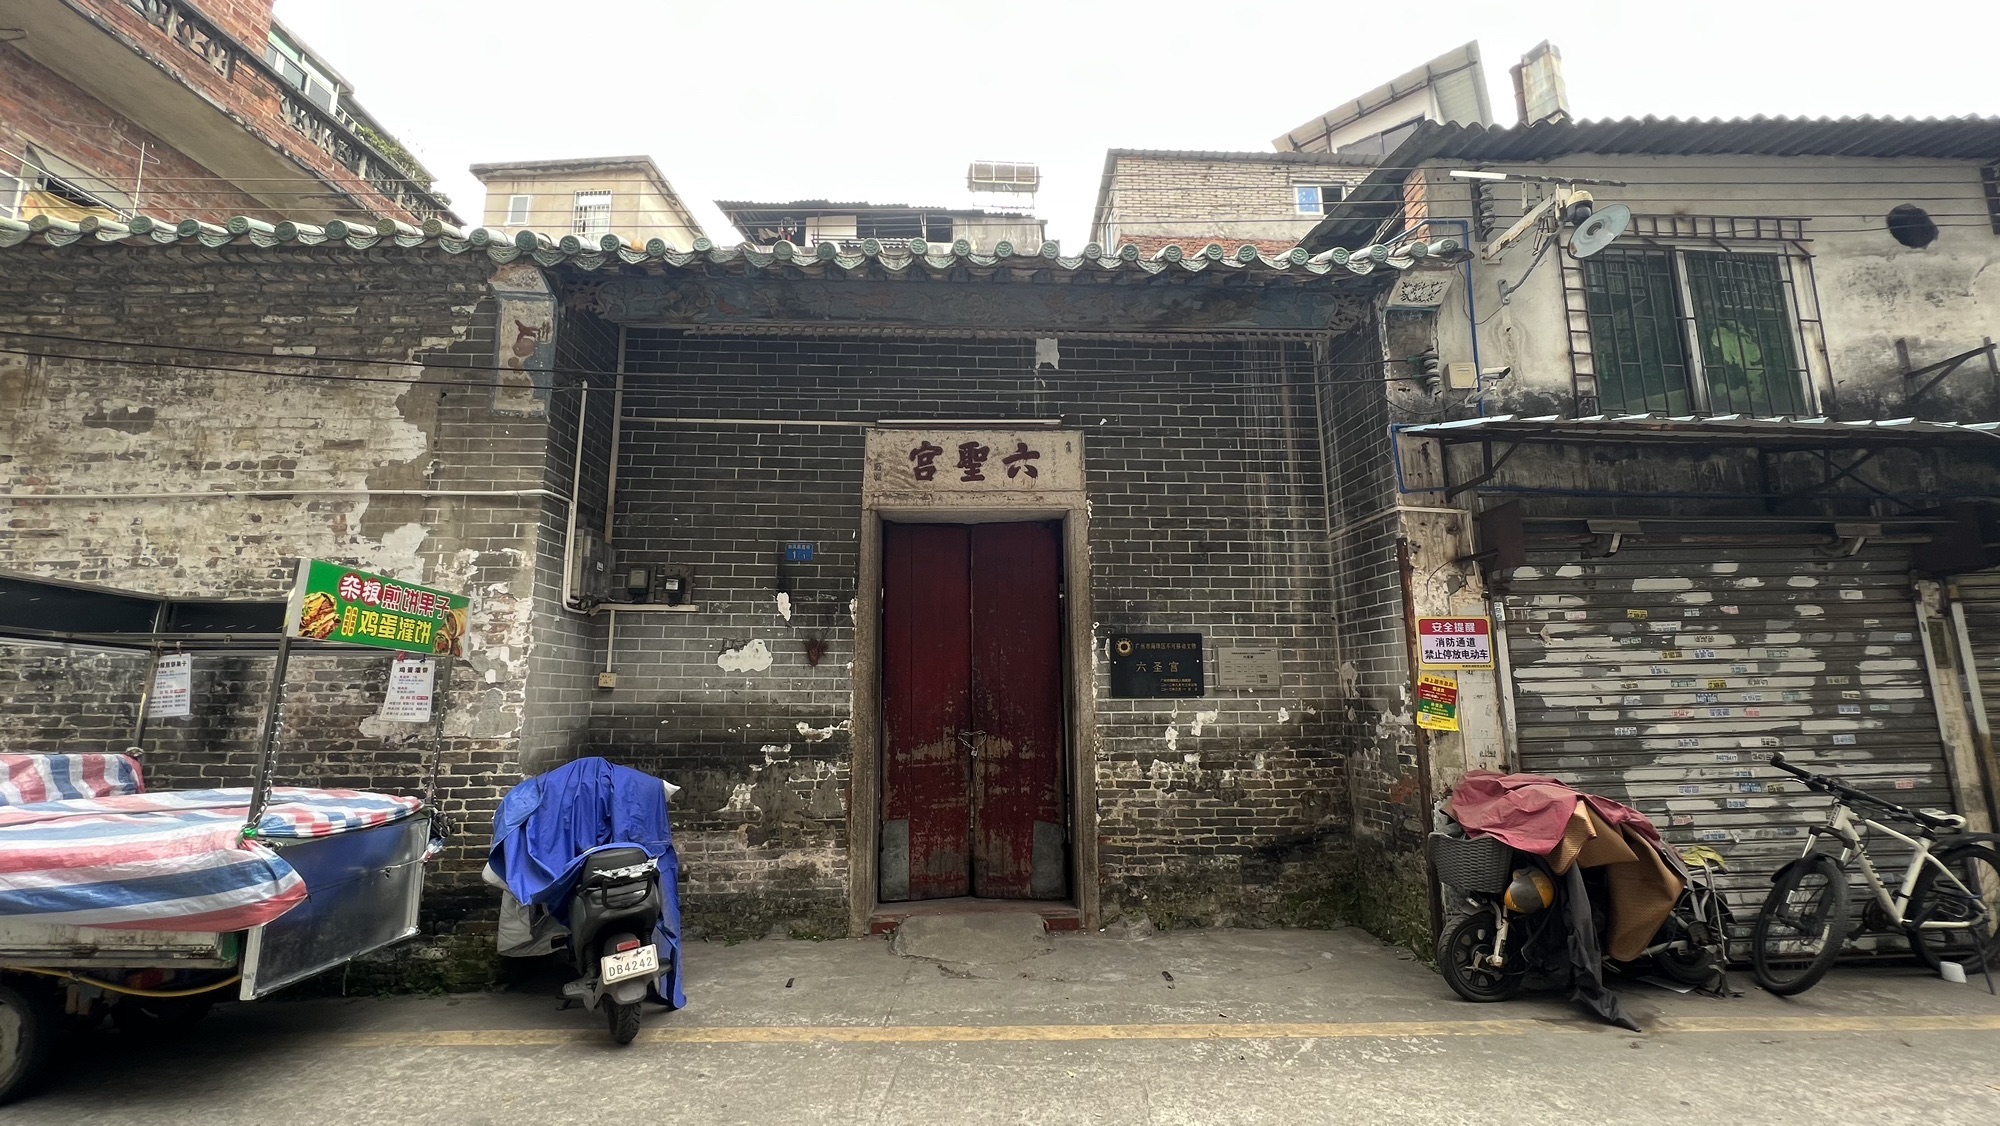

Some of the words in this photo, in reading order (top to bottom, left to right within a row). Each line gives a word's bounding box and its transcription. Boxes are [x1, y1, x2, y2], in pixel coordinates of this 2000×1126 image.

[340, 574, 451, 620] 杂粮煎饼果子
[358, 610, 433, 645] 鸡蛋灌饼
[1432, 622, 1476, 633] 安全提醒
[1435, 637, 1476, 647] 消防通道
[1425, 649, 1489, 660] 禁止停放电动车
[1135, 660, 1180, 673] 六圣宫
[608, 956, 653, 977] DB4242
